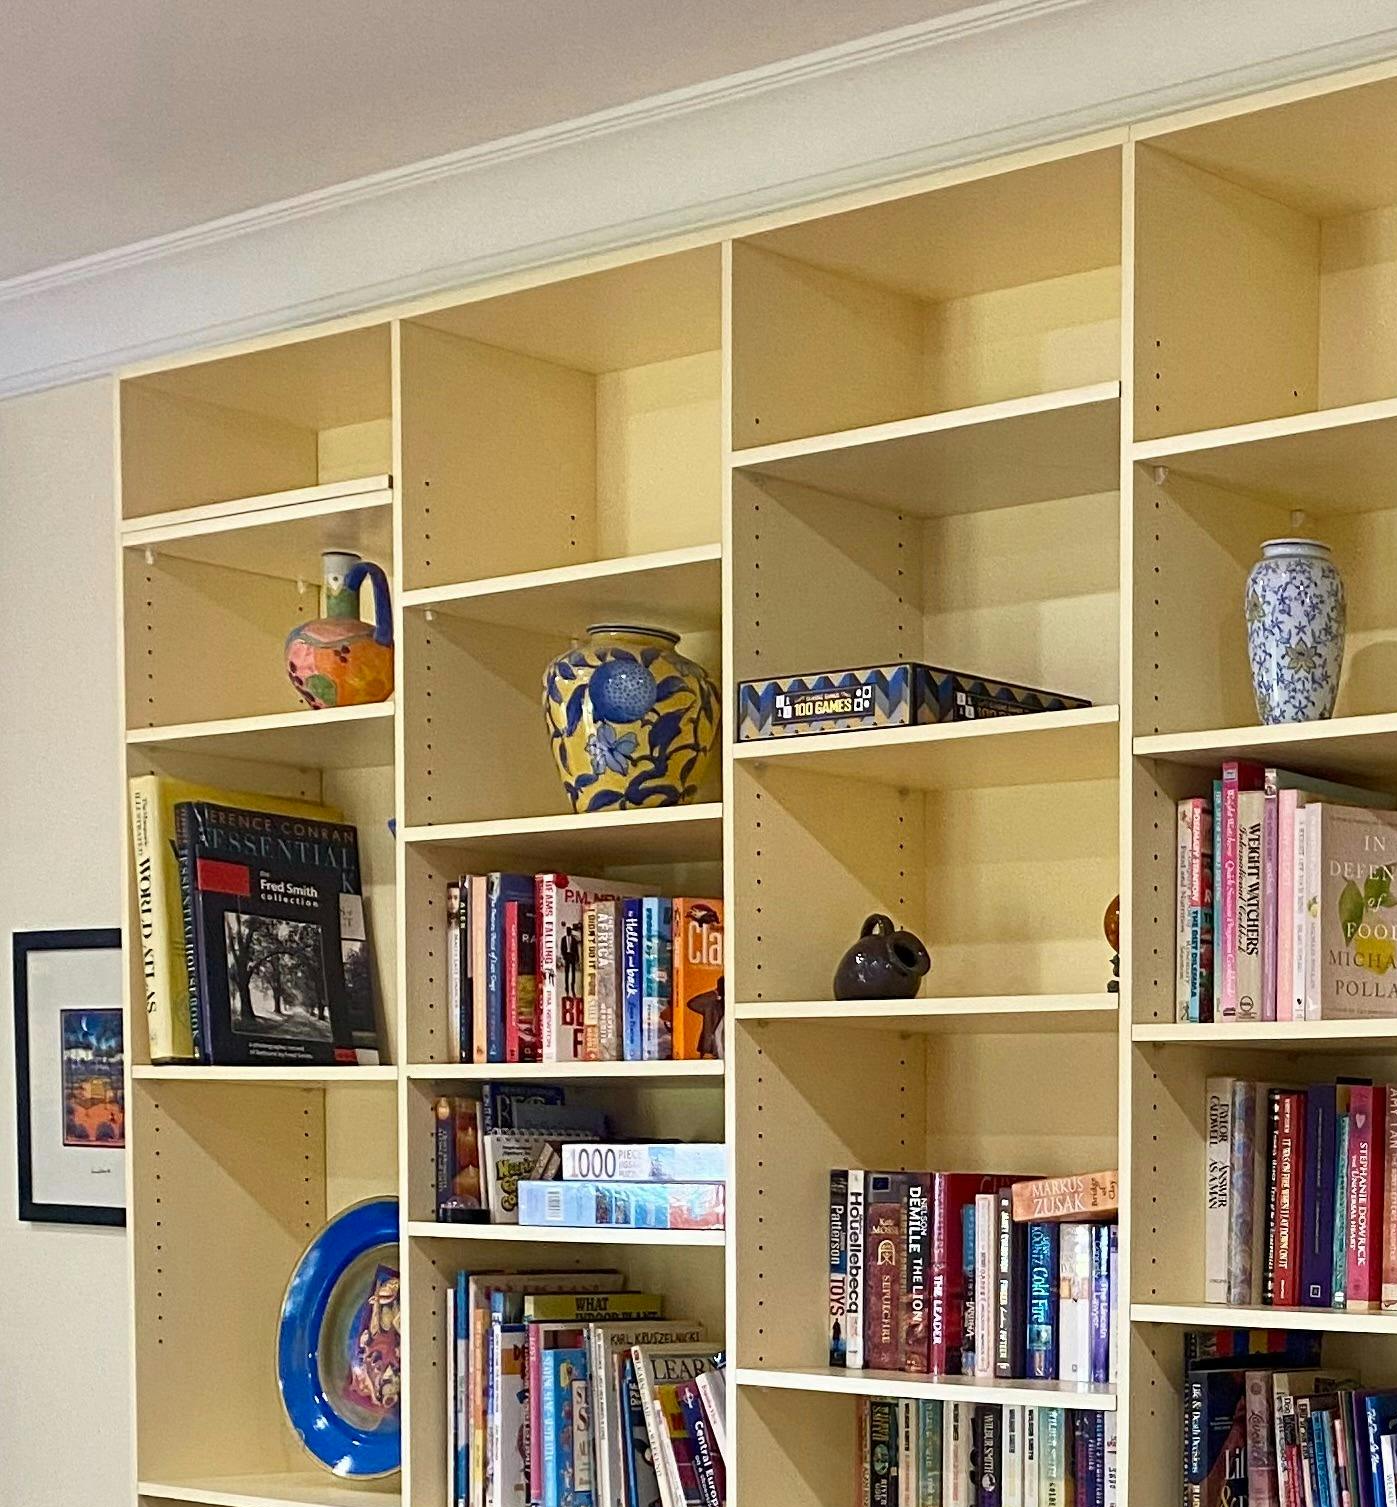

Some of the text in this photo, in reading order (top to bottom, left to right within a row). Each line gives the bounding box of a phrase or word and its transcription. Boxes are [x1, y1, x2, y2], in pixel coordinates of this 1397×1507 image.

[794, 698, 852, 717] 100 GAMES
[212, 826, 356, 869] ESSENTIAL
[280, 821, 354, 843] CONRAN
[1364, 834, 1386, 851] IN
[1191, 807, 1200, 902] ROSEMARY STANTON
[260, 879, 318, 899] Fred Smith
[260, 892, 319, 908] collection
[564, 889, 592, 905] P.M.
[1246, 822, 1261, 956] WEIGHT WATCHERS
[1368, 893, 1384, 912] of
[1190, 909, 1199, 928] THE
[137, 857, 158, 1015] WORLD ATLAS
[543, 921, 554, 972] FALLING
[597, 912, 609, 968] AFRICA
[624, 917, 639, 954] Hellas
[587, 960, 596, 970] IT
[1190, 952, 1199, 999] DILEMMA
[626, 968, 640, 997] back
[1208, 1096, 1220, 1146] CALDWELL
[1219, 1103, 1228, 1143] TAYLOR
[568, 1147, 617, 1178] 1000
[1030, 1175, 1085, 1198] MARKUS
[1208, 1185, 1219, 1210] MAN
[1218, 1158, 1229, 1207] ANSWER
[1350, 1169, 1358, 1219] UNIVERSAL
[919, 1197, 929, 1236] NELSON
[1033, 1194, 1086, 1217] ZUSAK
[1357, 1142, 1369, 1266] STEPHANIE DOWRICK
[847, 1191, 863, 1314] Houellebecq
[1279, 1227, 1289, 1249] DOWN
[829, 1205, 846, 1317] Patterson TOYS
[907, 1186, 925, 1324] DEMILLE THE LION
[1031, 1267, 1050, 1297] Cold
[575, 1296, 609, 1312] WHAT
[880, 1275, 891, 1345] SEPULCHRE
[932, 1274, 944, 1345] THE LEADER
[1031, 1298, 1050, 1325] Fire
[610, 1334, 633, 1346] KARL
[1191, 1383, 1202, 1402] Life
[1191, 1410, 1202, 1436] Death
[694, 1420, 711, 1470] Central
[983, 1414, 995, 1473] WILBUR SMITH
[1191, 1436, 1200, 1474] Decisions
[880, 1478, 888, 1505] RIVER
[1386, 1473, 1394, 1505] WEEKLY
